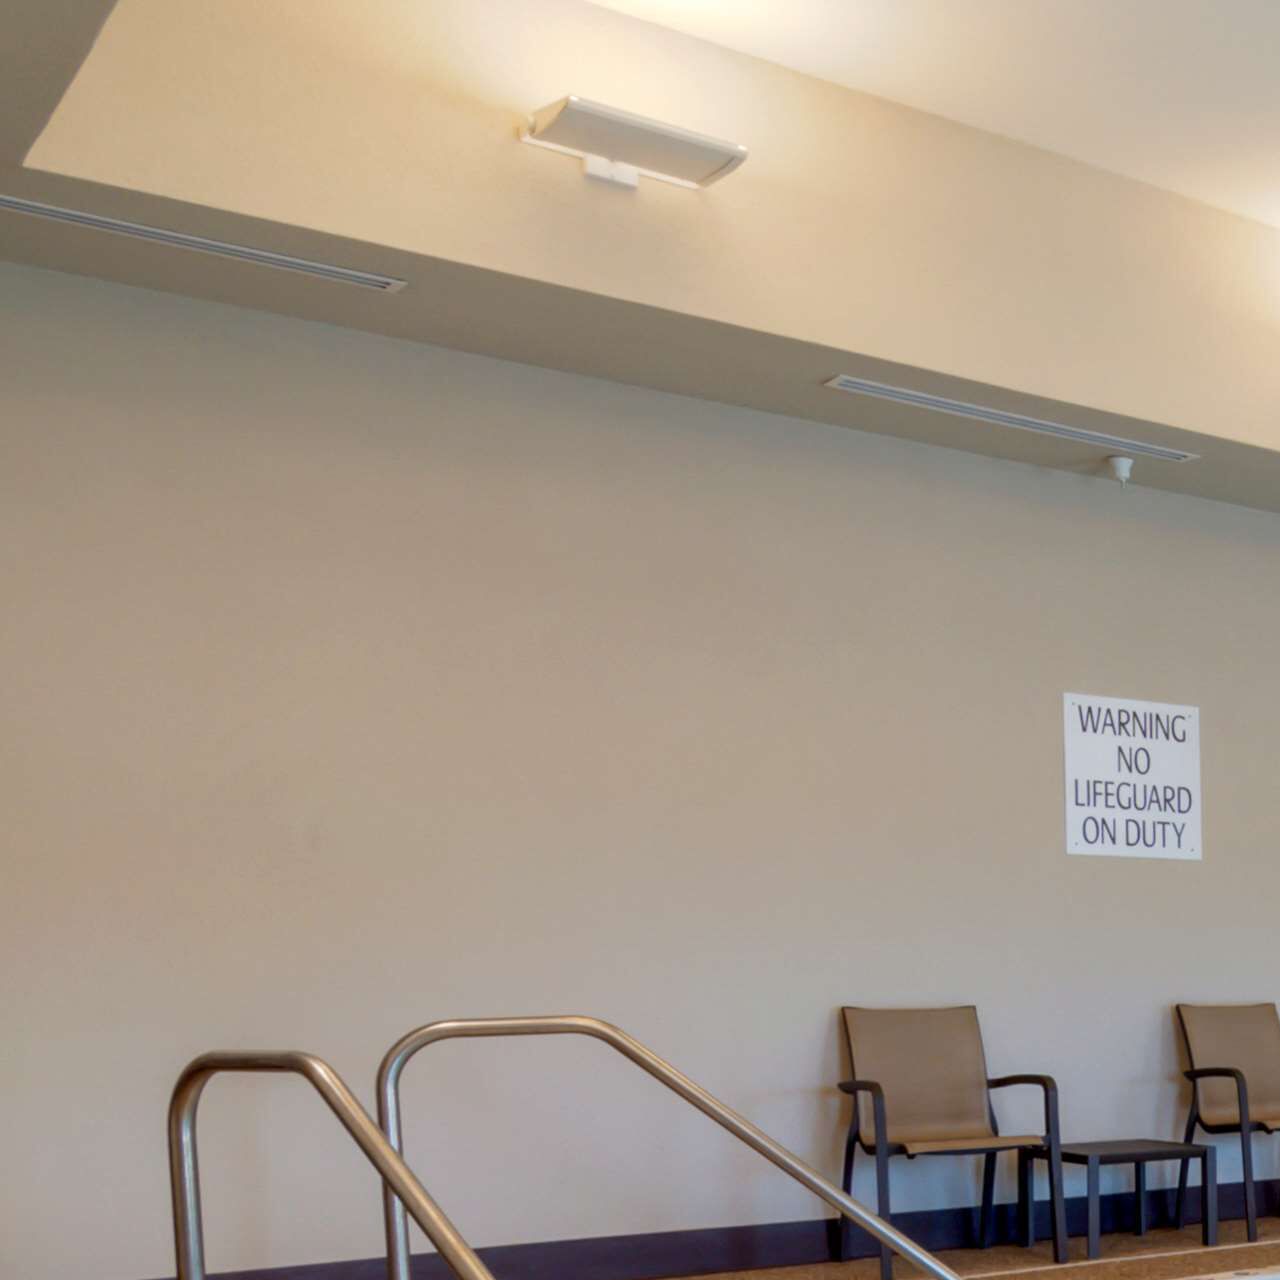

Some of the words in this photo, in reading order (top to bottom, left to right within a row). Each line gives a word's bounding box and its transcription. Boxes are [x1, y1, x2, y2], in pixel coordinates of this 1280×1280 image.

[1077, 704, 1187, 743] WARNING
[1117, 745, 1151, 775] NO
[1074, 778, 1193, 814] LIFEGUARD
[1082, 816, 1117, 845] ON
[1125, 818, 1187, 849] DUTY
